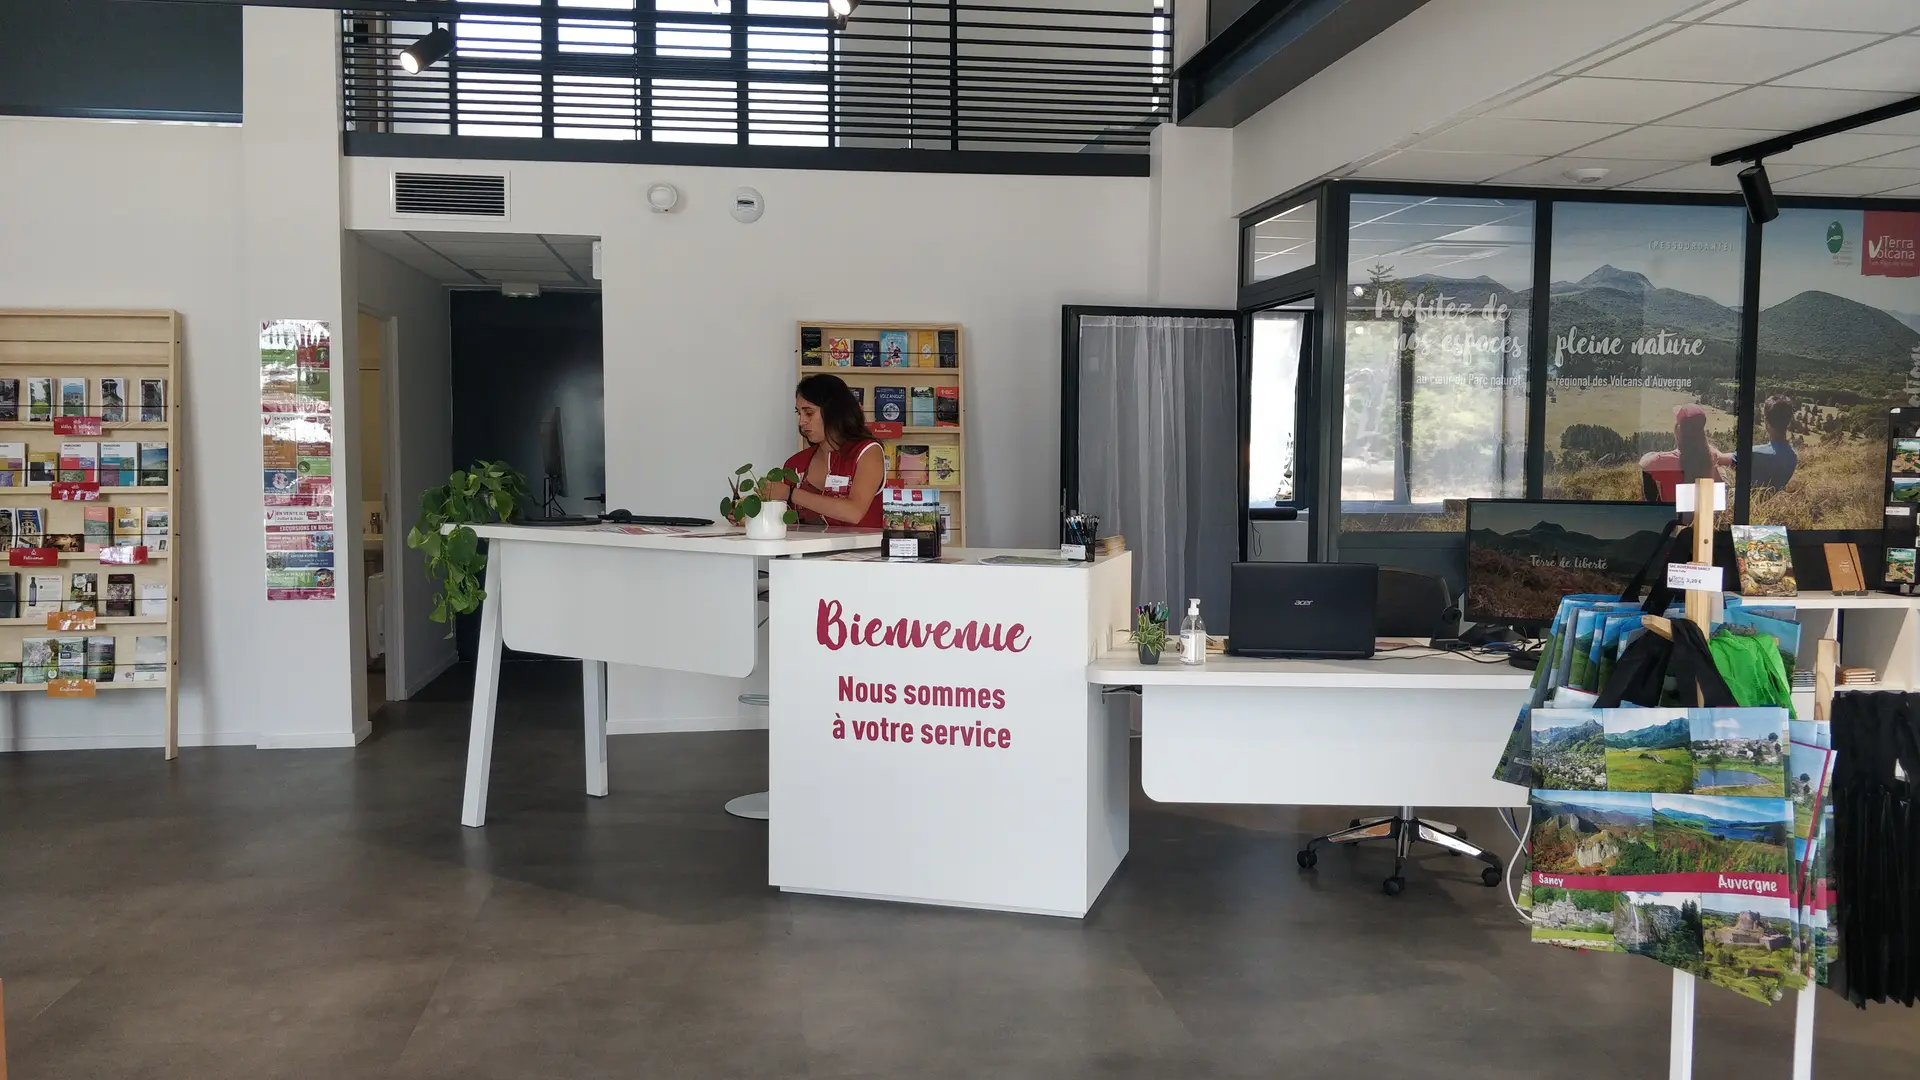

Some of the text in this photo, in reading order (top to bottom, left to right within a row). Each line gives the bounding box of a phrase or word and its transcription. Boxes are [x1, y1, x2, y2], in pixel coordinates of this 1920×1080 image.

[1868, 235, 1916, 260] Volcana
[1882, 235, 1914, 249] Terra
[1375, 288, 1512, 324] Profitez de
[1393, 332, 1525, 366] nos espaces
[1555, 325, 1706, 367] pleine nature
[1416, 375, 1427, 384] au
[1455, 374, 1466, 385] du
[1468, 373, 1488, 386] Parc
[1555, 374, 1692, 390] régional des Volcans d'Auvergne
[1529, 554, 1609, 570] Terre de liberté
[816, 598, 1032, 653] Bienvenue
[838, 675, 1007, 709] Nous sommes
[832, 713, 1012, 749] à votre service
[1538, 874, 1778, 893] Sancy Auvergne
